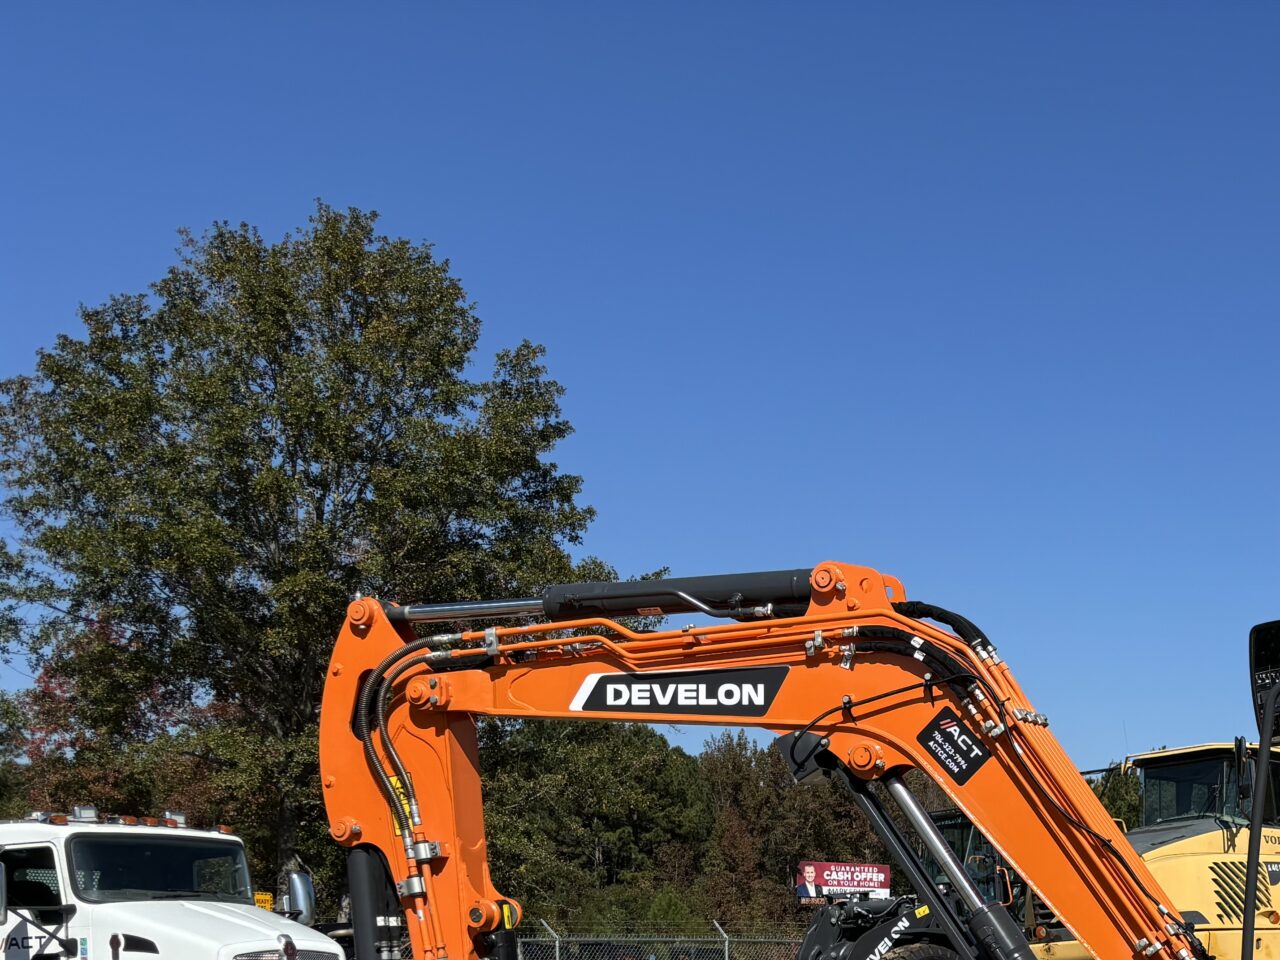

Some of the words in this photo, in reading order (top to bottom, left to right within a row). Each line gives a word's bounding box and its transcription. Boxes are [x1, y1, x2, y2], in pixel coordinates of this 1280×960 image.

[606, 683, 765, 706] DEVELON
[927, 740, 960, 774] ACTCE.COM
[823, 870, 851, 881] CASH
[853, 872, 885, 882] OFFER
[830, 865, 878, 873] GUARANTEED
